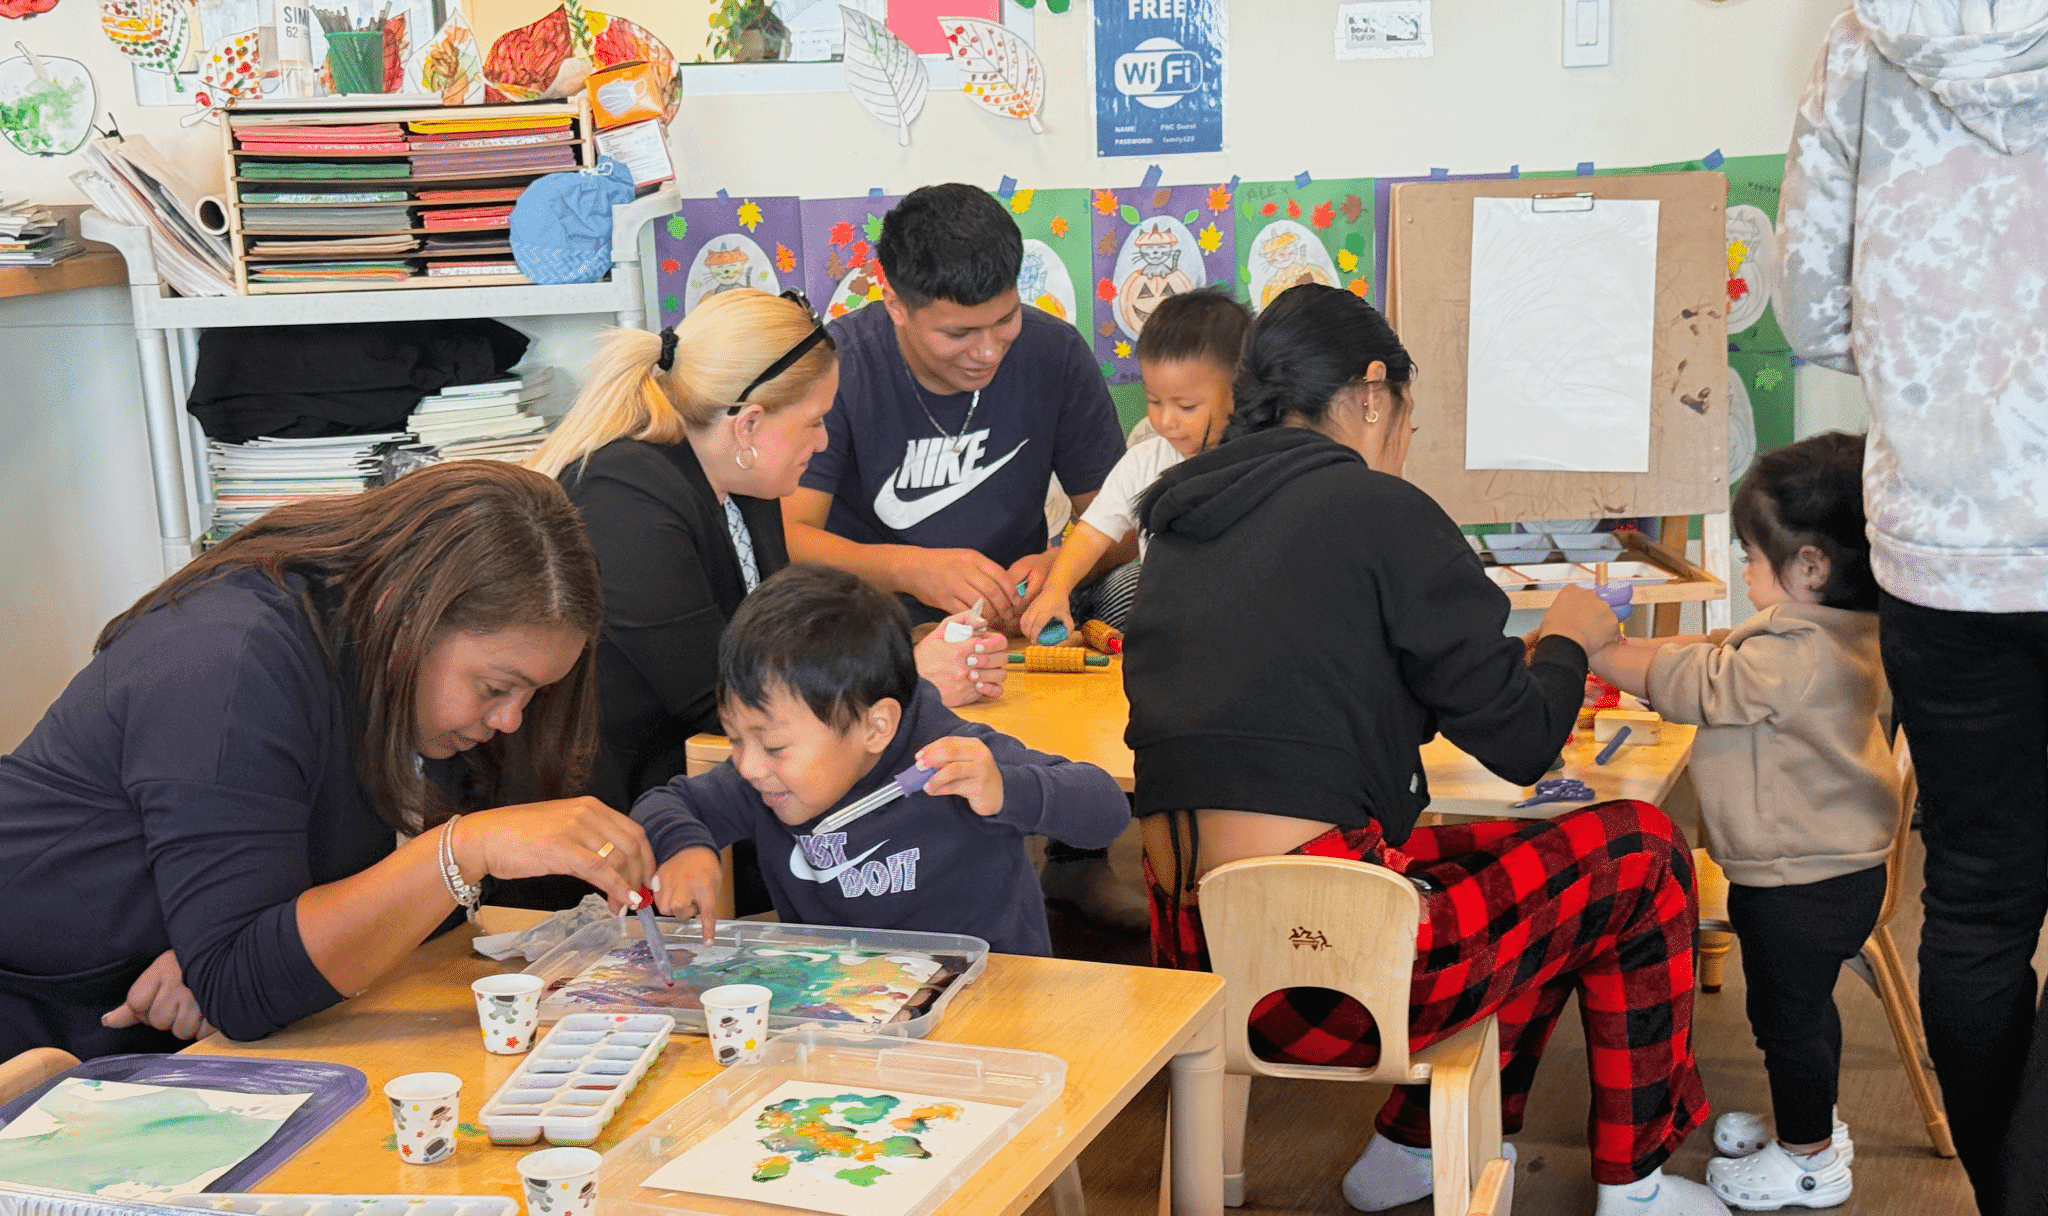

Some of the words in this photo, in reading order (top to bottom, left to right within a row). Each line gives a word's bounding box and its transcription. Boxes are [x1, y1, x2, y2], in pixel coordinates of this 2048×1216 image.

[1129, 0, 1186, 19] FREE
[286, 26, 298, 38] 62
[896, 428, 990, 489] NIKE
